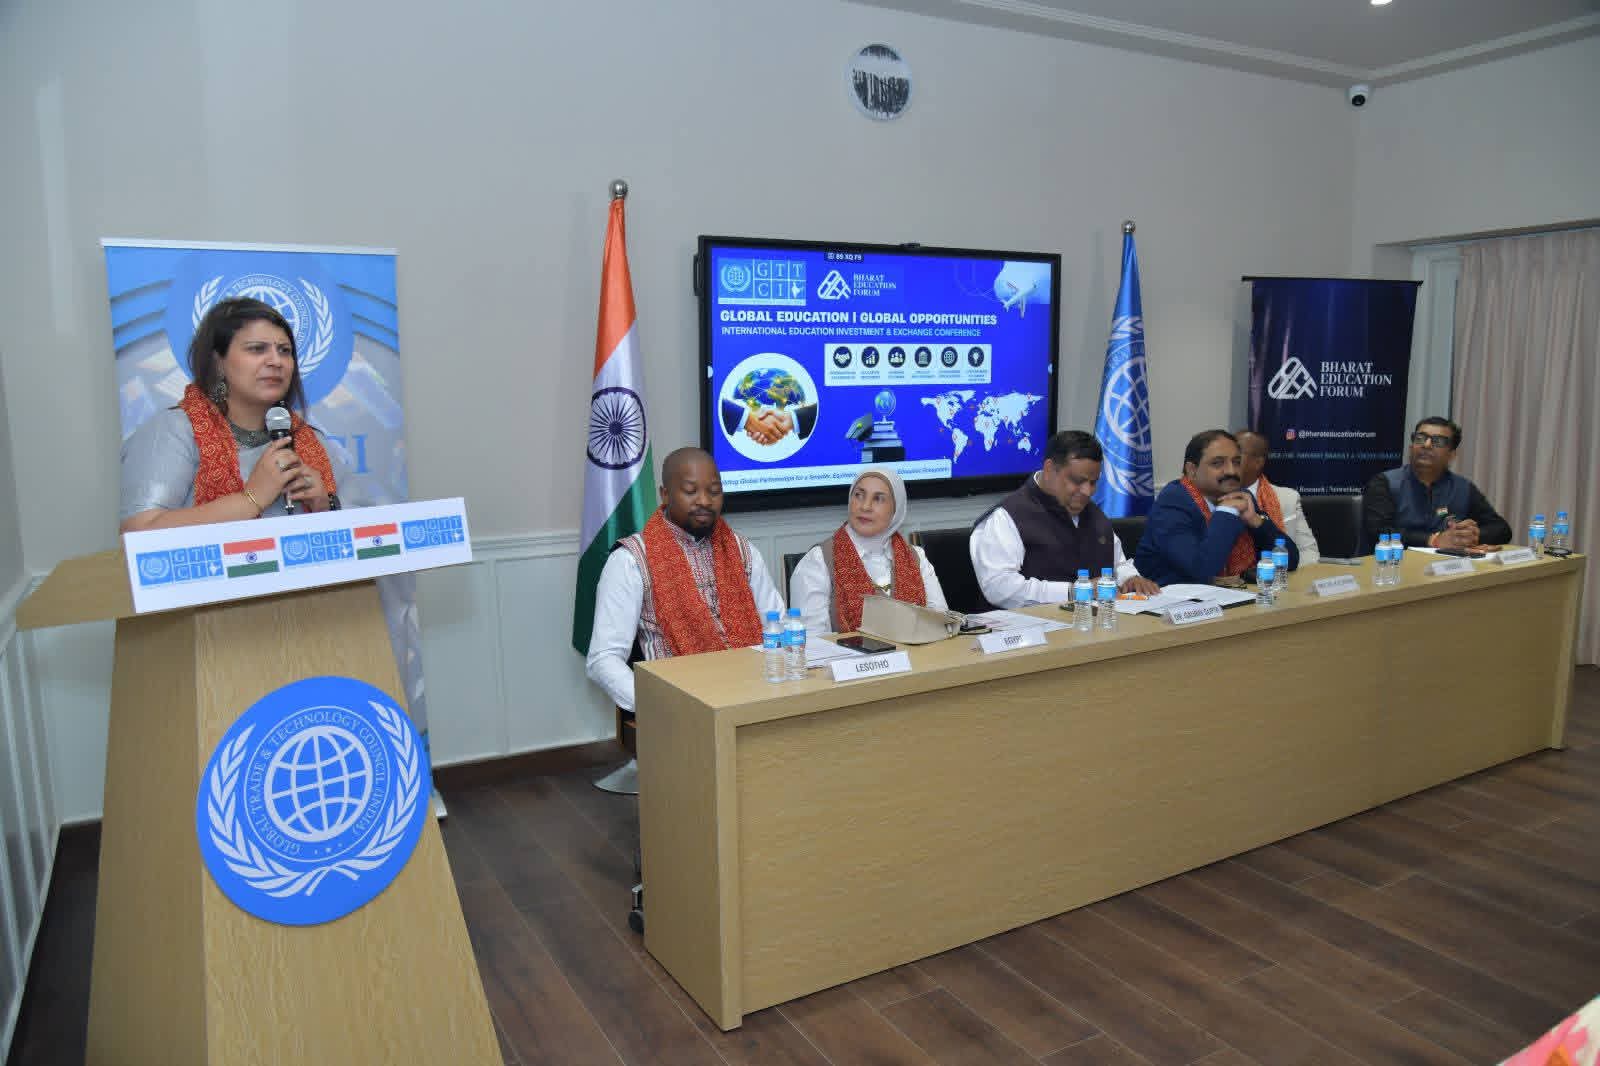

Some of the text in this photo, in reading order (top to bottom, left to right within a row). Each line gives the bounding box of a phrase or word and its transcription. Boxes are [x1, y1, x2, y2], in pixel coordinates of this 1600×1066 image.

[853, 273, 885, 282] BHARAT
[853, 281, 897, 290] EDUCATION
[853, 289, 881, 297] FORUM
[720, 310, 773, 323] GLOBAL
[776, 310, 849, 324] EDUCATION
[860, 311, 907, 325] GLOBAL
[909, 313, 998, 326] OPPORTUNITIES
[721, 326, 982, 338] INTERNATIONAL EDUCATION INVESTMENT & EXCHANGE CONFERENCE
[1320, 361, 1374, 374] BHARAT
[1319, 374, 1393, 386] EDUCATION
[1319, 386, 1365, 398] FORUM
[855, 659, 890, 673] LESOTHO
[248, 761, 266, 816] TRADE
[268, 710, 361, 747] TECHNOLOGY
[358, 727, 387, 784] COUNCIL
